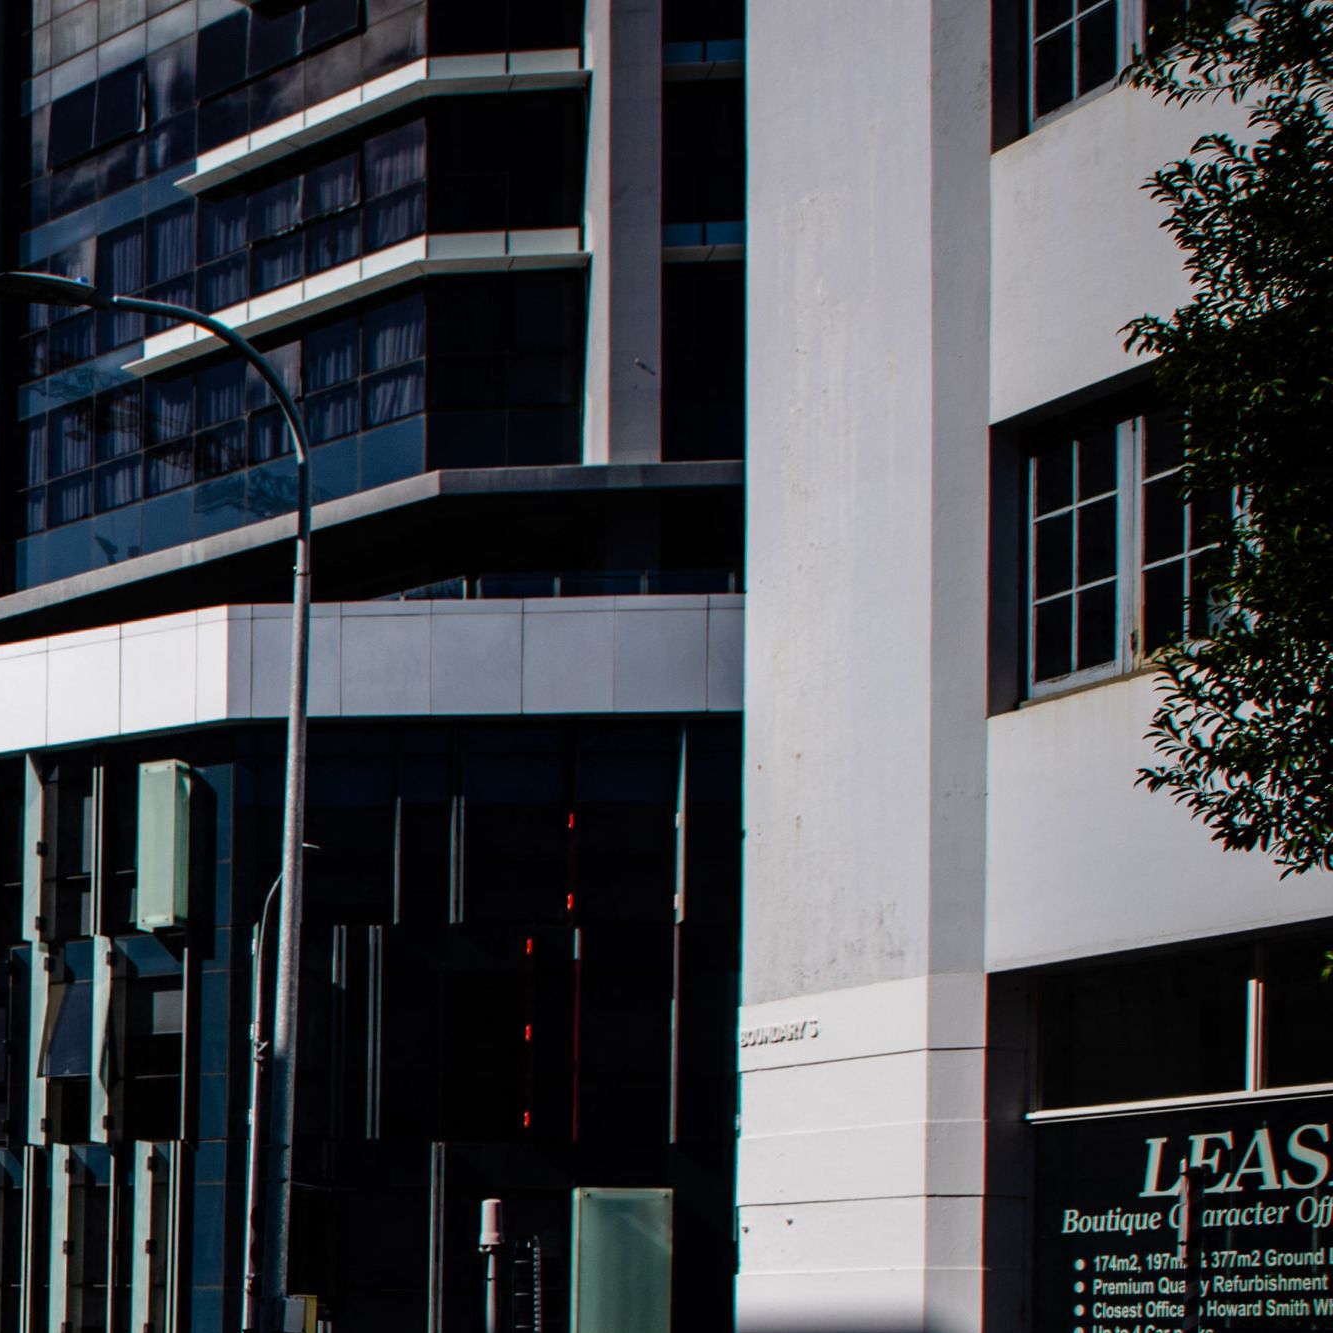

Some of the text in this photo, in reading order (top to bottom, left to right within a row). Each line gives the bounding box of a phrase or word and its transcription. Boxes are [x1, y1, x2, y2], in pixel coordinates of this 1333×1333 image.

[1139, 1123, 1333, 1197] LEAS
[1061, 1206, 1162, 1236] Boutique
[1168, 1201, 1290, 1228] Caracter
[1093, 1254, 1142, 1273] 174m2,
[1146, 1253, 1187, 1270] 197m
[1211, 1250, 1261, 1268] 377m2
[1265, 1248, 1324, 1267] Ground
[1093, 1274, 1328, 1298] Premium Quay Refurbishment
[1093, 1302, 1142, 1318] Closest
[1206, 1300, 1262, 1317] Howard
[1265, 1299, 1309, 1317] Smith
